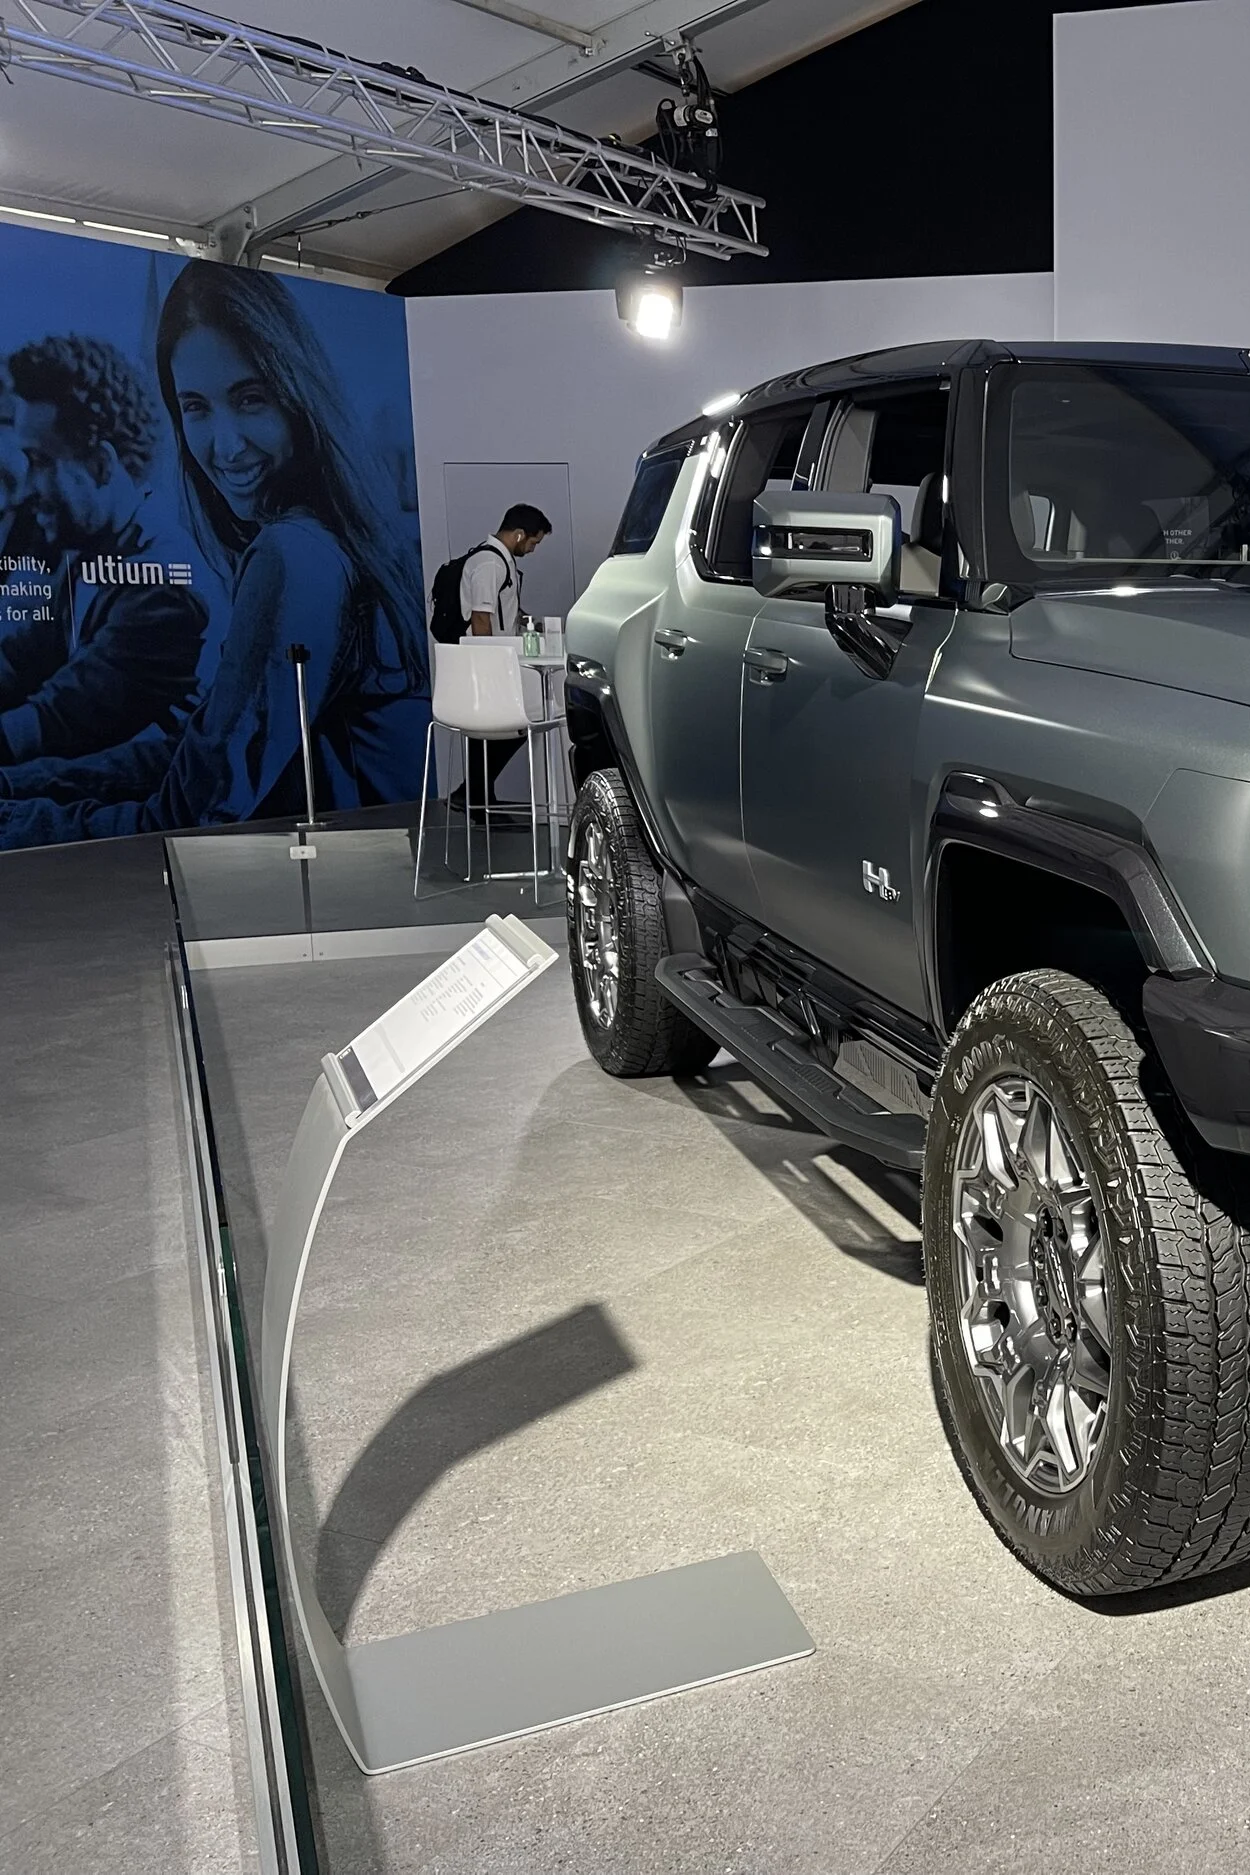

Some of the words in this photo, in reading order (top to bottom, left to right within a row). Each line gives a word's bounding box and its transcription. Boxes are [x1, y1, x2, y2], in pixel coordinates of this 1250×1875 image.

[81, 555, 164, 585] ultium
[0, 581, 52, 600] making
[7, 606, 28, 621] for
[33, 606, 54, 621] all.
